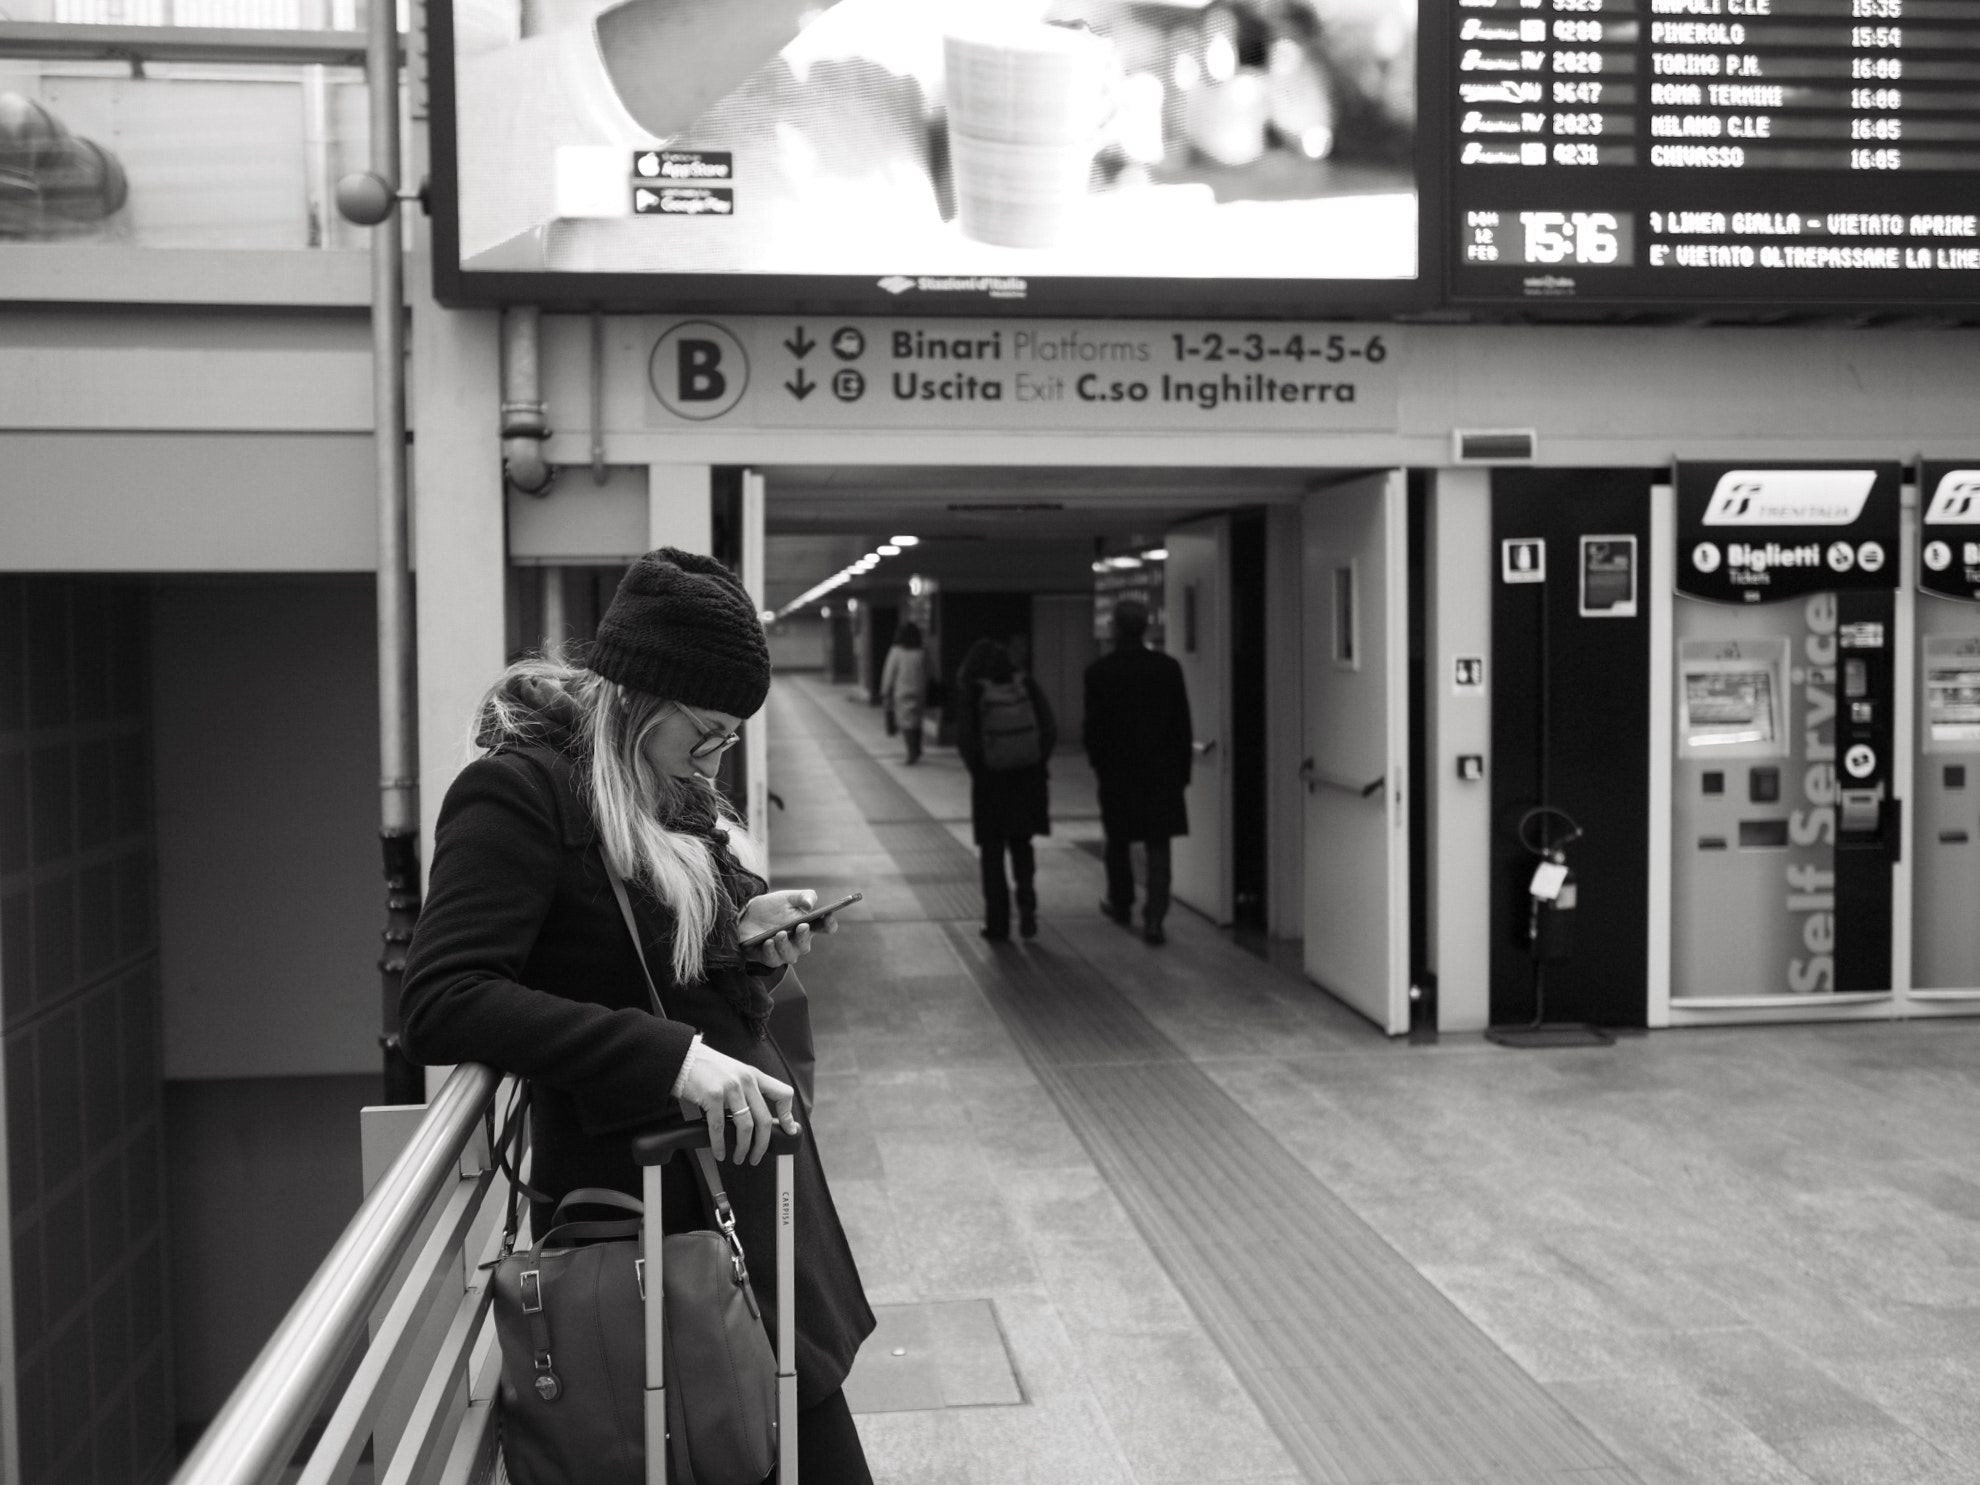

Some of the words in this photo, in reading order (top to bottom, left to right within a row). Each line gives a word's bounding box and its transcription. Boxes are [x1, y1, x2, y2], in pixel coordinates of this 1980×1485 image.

[1652, 22, 1745, 44] PINEROLO
[1852, 27, 1901, 47] 15:54
[1652, 53, 1720, 75] TORINO
[1852, 58, 1902, 79] 16:00
[1651, 83, 1701, 105] ROMA
[1708, 85, 1784, 106] TERMINI
[1851, 89, 1901, 109] 16:00
[1651, 115, 1722, 137] MILANO
[1851, 119, 1901, 139] 16:05
[1651, 145, 1744, 167] CHIVASSO
[1851, 149, 1900, 169] 16:05
[1520, 212, 1617, 263] 15:16
[1668, 212, 1726, 233] LINEA
[1732, 212, 1801, 234] GIALLA
[1827, 214, 1904, 235] VIETATO
[1910, 215, 1977, 236] APRIRE
[1676, 245, 1755, 267] VIETATO
[1760, 246, 1900, 268] OLTREPASSARE
[1906, 248, 1932, 268] LA
[892, 330, 1000, 359] Binari
[1013, 330, 1151, 362] Platforms
[1172, 333, 1386, 362] 1-2-3-4-5-6
[677, 338, 727, 401] B
[894, 373, 1000, 399] Uscita
[1014, 371, 1065, 402] Exit
[1077, 374, 1147, 400] C.so
[1164, 374, 1354, 408] Inghilterra
[1728, 544, 1819, 573] Biglietti
[1729, 568, 1771, 585] Tickets
[1789, 592, 1837, 847] Service
[1787, 865, 1836, 993] Self
[782, 1191, 790, 1227] CARPISA
